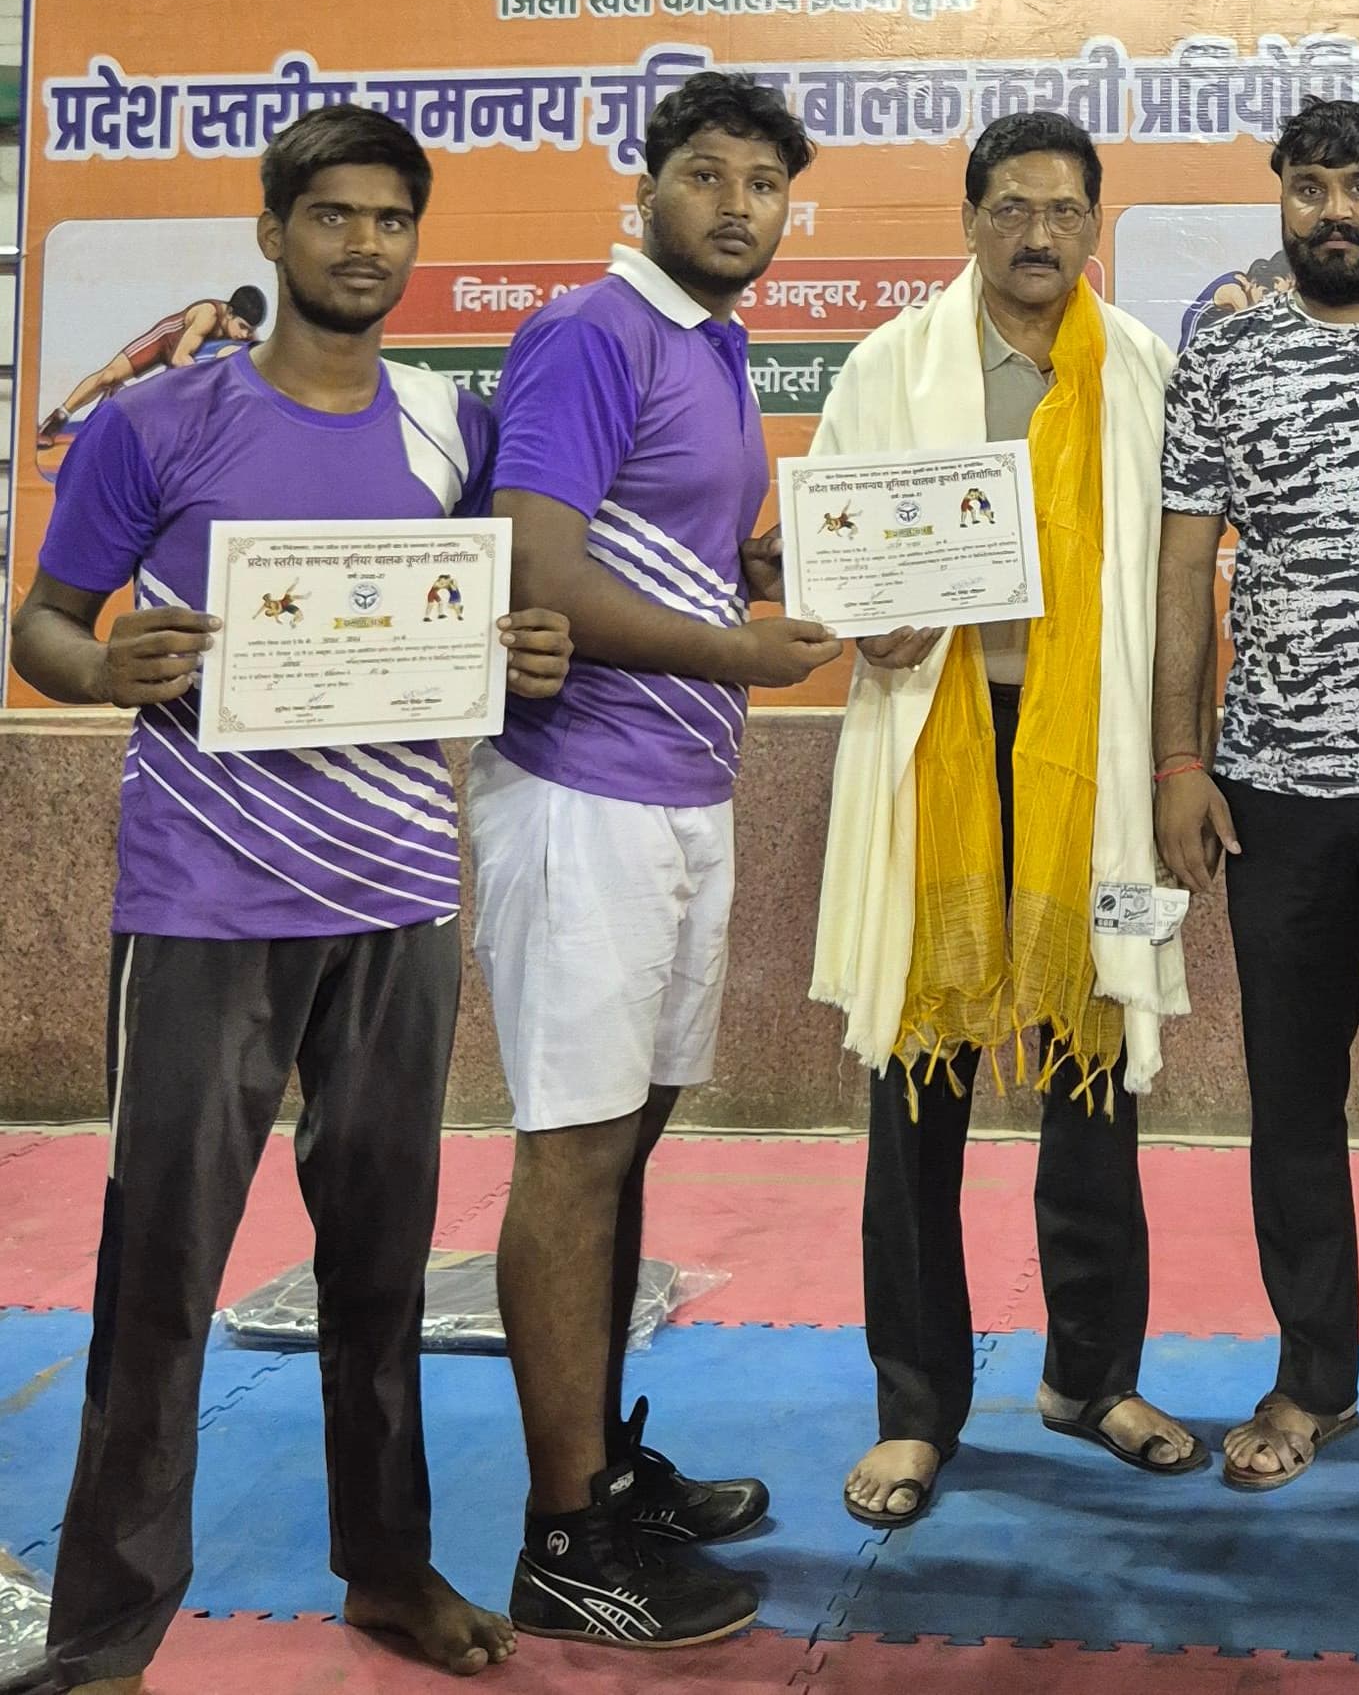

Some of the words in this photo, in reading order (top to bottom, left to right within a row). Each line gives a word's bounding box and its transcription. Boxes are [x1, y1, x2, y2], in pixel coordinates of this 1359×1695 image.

[51, 64, 180, 151] प्रदेश
[799, 68, 968, 137] बालक
[454, 276, 543, 312] दिनांक:
[766, 280, 867, 319] अक्टूबर,
